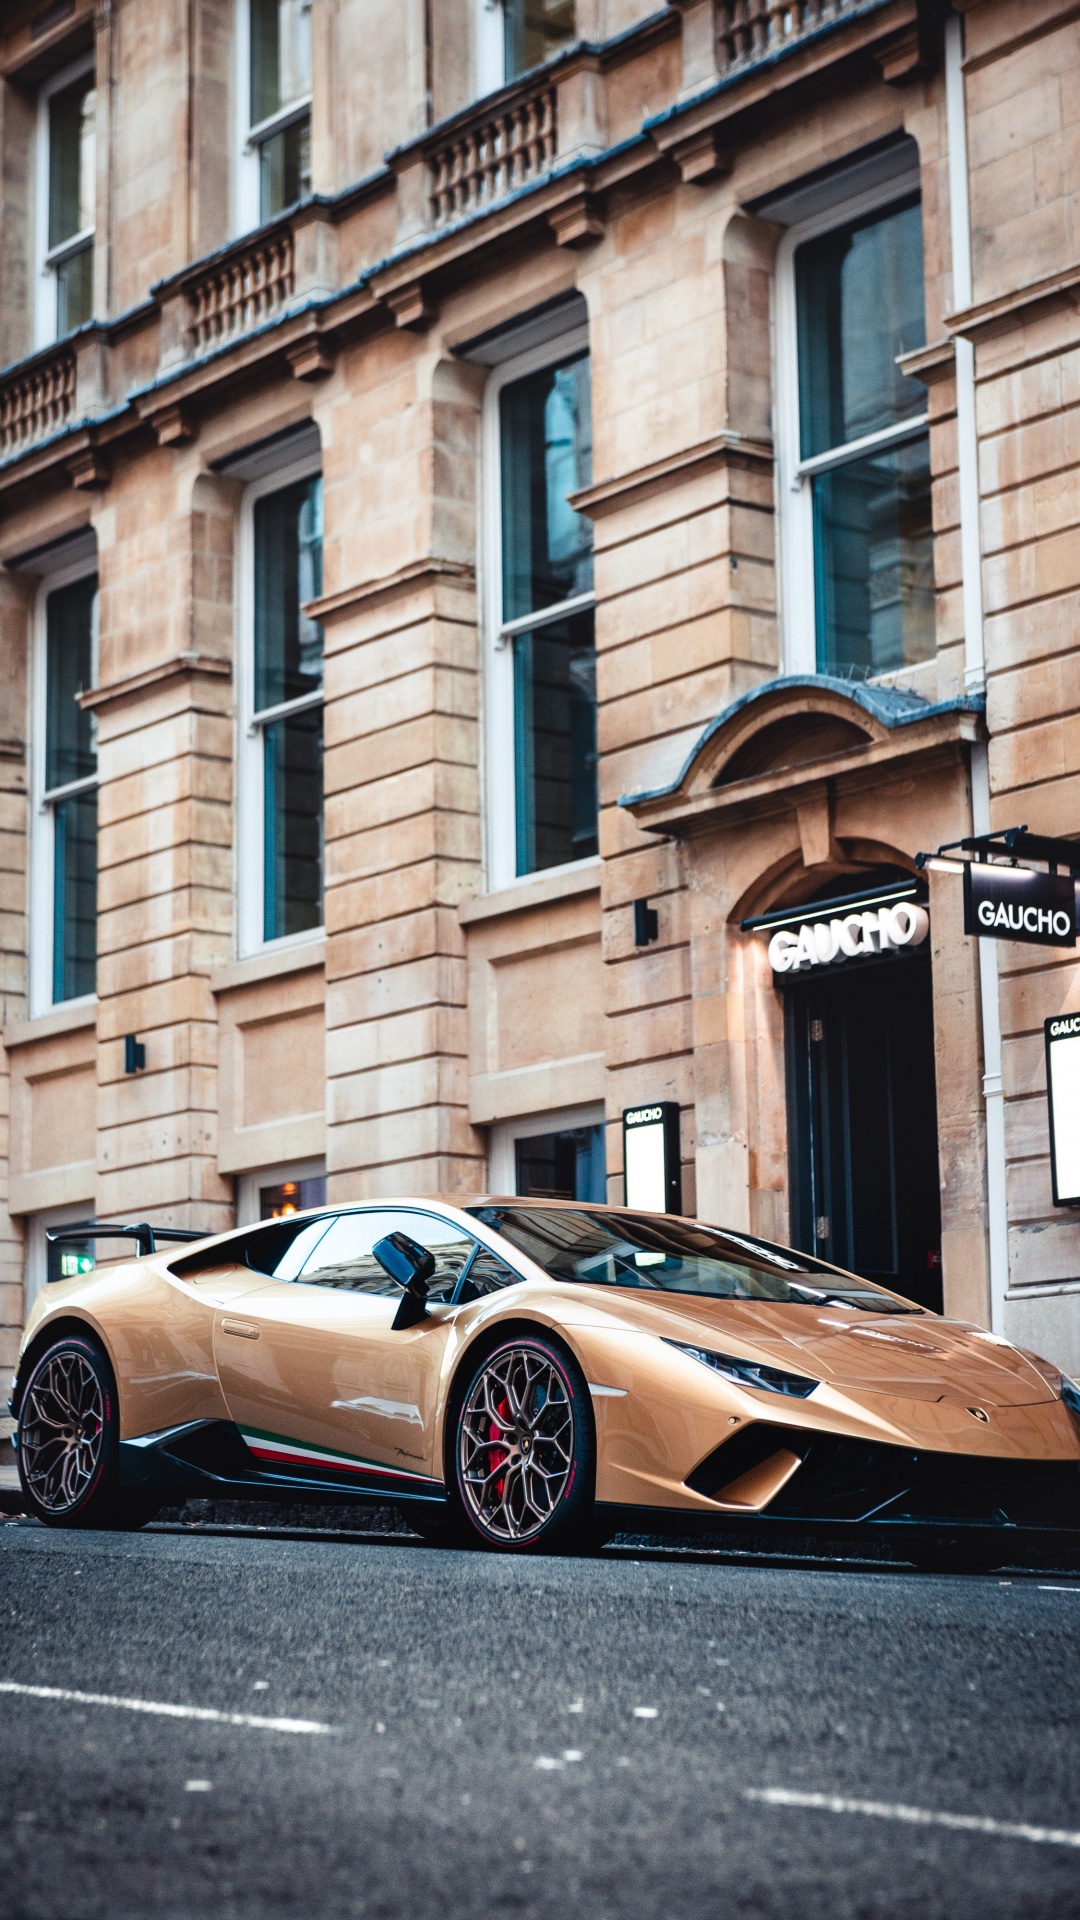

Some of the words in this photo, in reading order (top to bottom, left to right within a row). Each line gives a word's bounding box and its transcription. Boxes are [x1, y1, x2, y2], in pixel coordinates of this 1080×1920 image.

[978, 900, 1071, 936] GAUCHO
[768, 901, 928, 974] GAUCHO
[626, 1106, 662, 1125] GAUCHO
